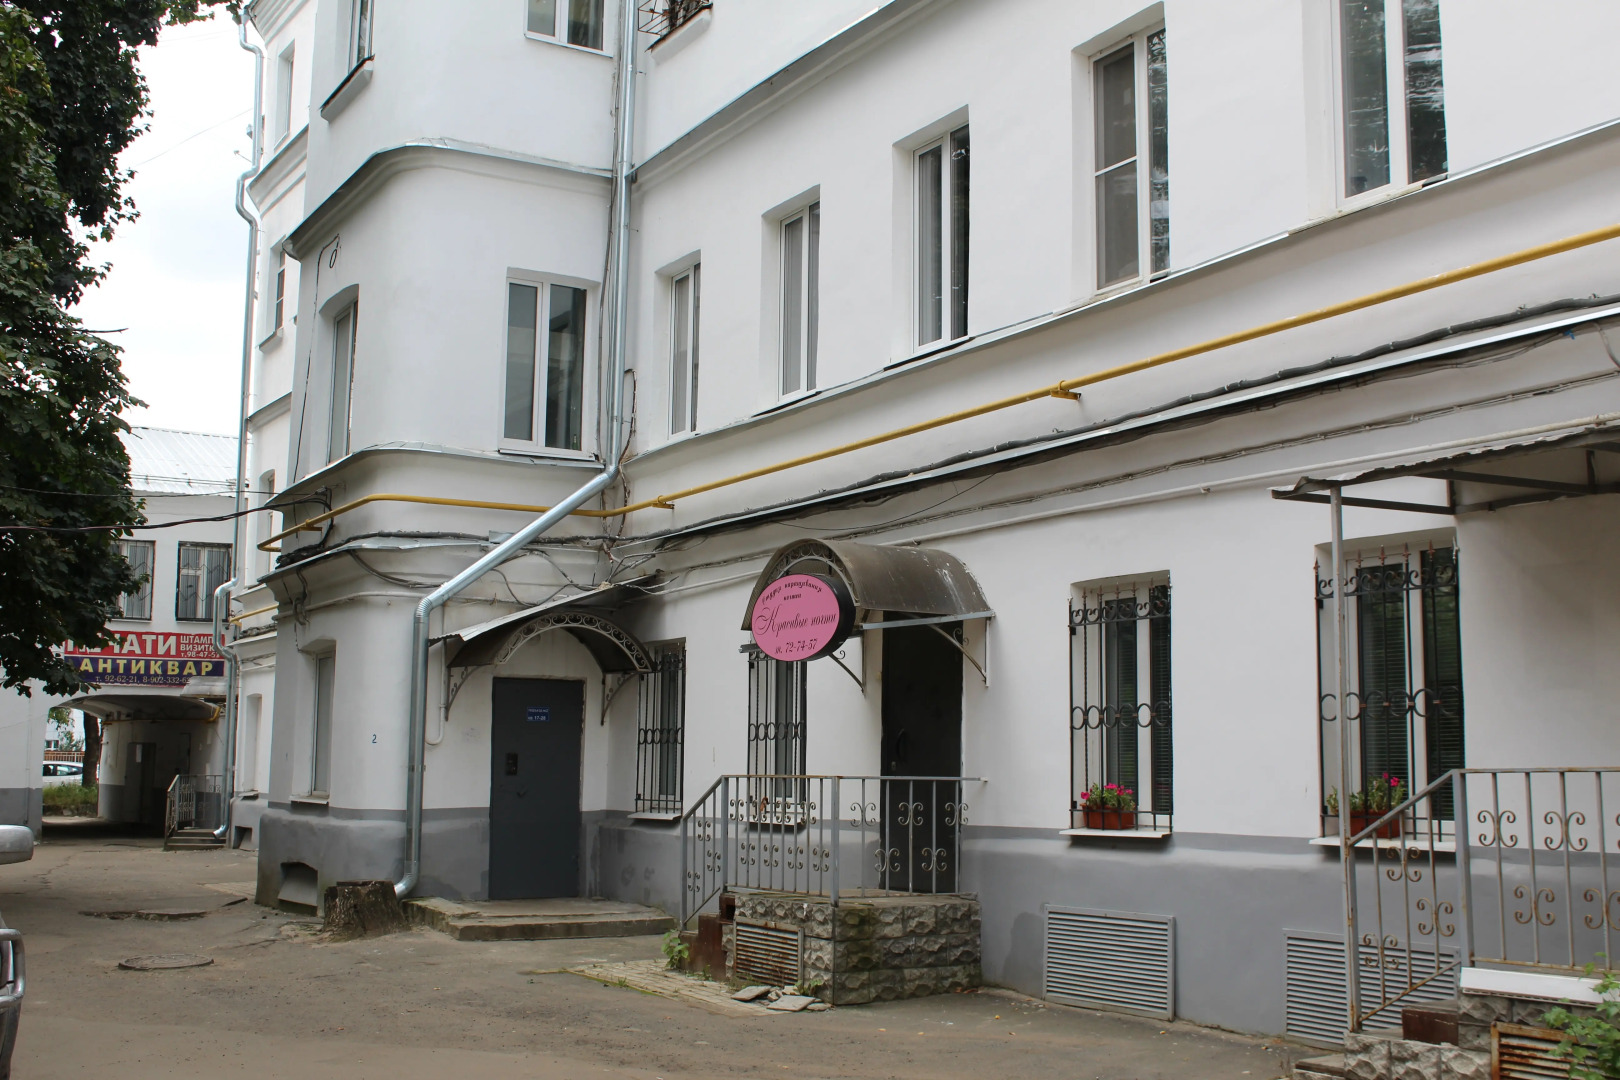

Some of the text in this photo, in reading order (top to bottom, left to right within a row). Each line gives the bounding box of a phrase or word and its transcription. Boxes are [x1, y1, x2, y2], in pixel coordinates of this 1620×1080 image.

[754, 604, 837, 638] Красивые ногти
[67, 633, 177, 656] ЧАТИ
[180, 635, 214, 644] ШТАМП
[180, 643, 215, 651] ВИЗИТК
[79, 658, 213, 676] АНТИКВАР
[371, 733, 377, 744] 2
